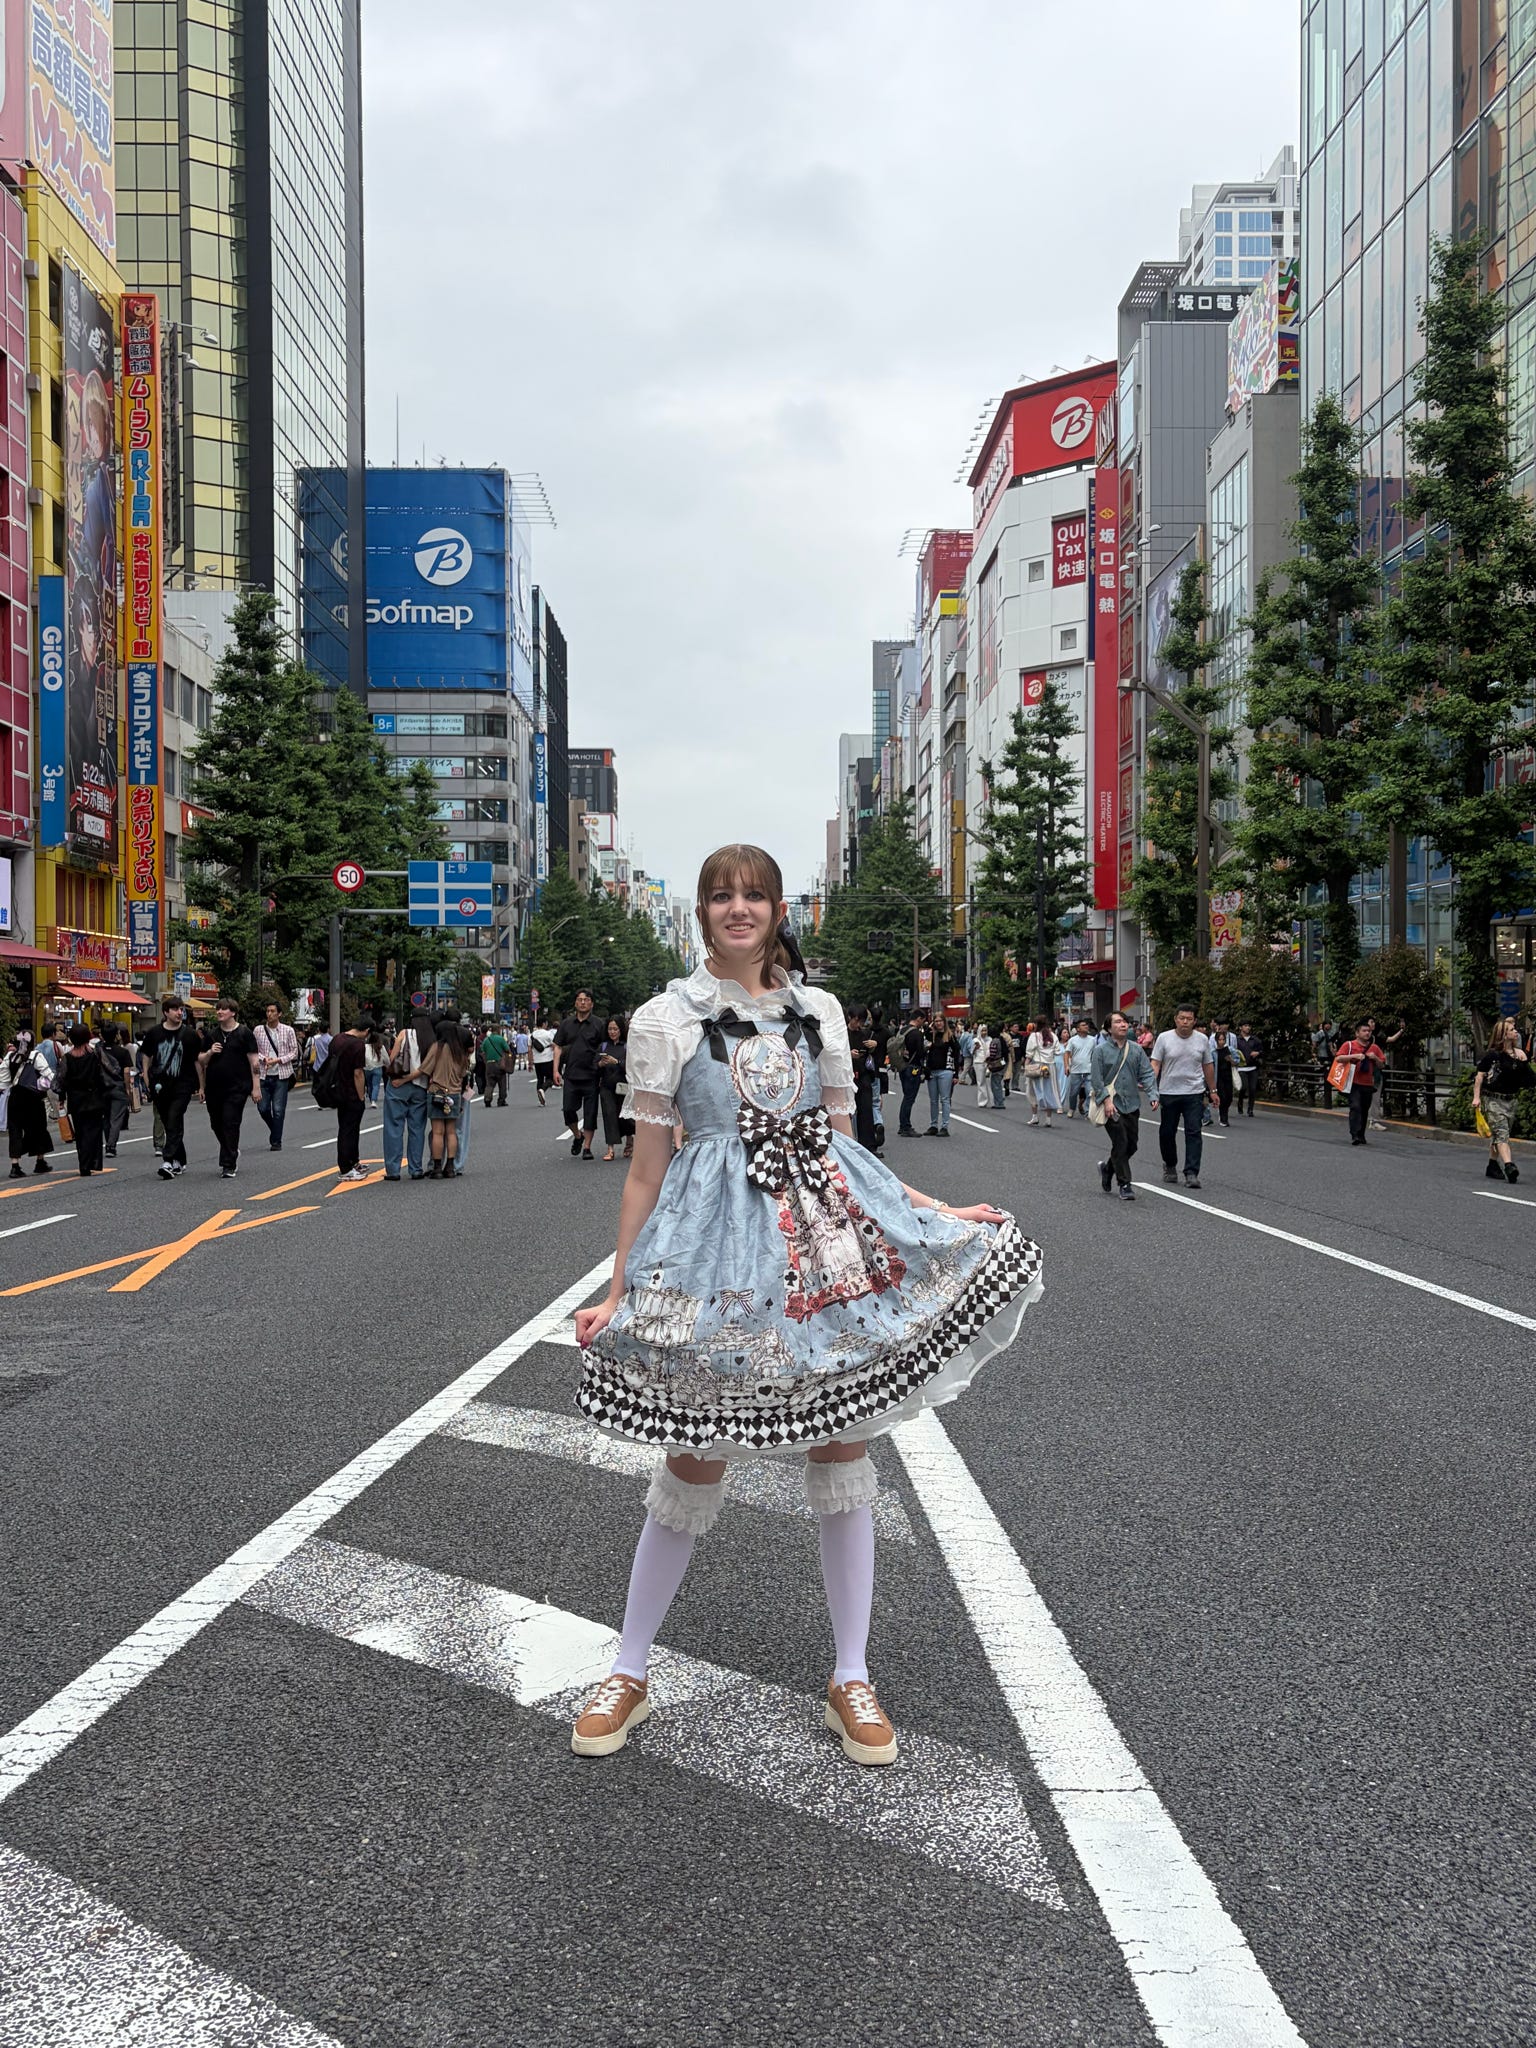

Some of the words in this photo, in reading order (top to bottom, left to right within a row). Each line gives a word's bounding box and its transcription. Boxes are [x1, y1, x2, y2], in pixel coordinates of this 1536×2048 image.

[32, 2, 110, 156] 高額買取
[129, 327, 150, 342] 買取
[129, 343, 151, 358] 販売
[129, 360, 152, 375] 市場
[131, 376, 151, 449] ムーラン
[131, 449, 151, 527] AKIBA
[1057, 543, 1082, 557] Tax
[1057, 560, 1085, 579] 快速
[1099, 528, 1116, 614] 坂口電熱
[132, 532, 151, 657] 中央通りホビー館
[365, 598, 474, 631] Sofmap
[42, 625, 63, 692] GiGO
[1048, 671, 1068, 680] カメラ
[133, 671, 153, 785] 全フロアホビー
[378, 718, 393, 730] 8F
[340, 870, 358, 885] 50
[446, 863, 468, 875] 上野
[132, 901, 156, 913] 2F
[134, 913, 154, 945] 買取
[132, 946, 157, 957] フロア
